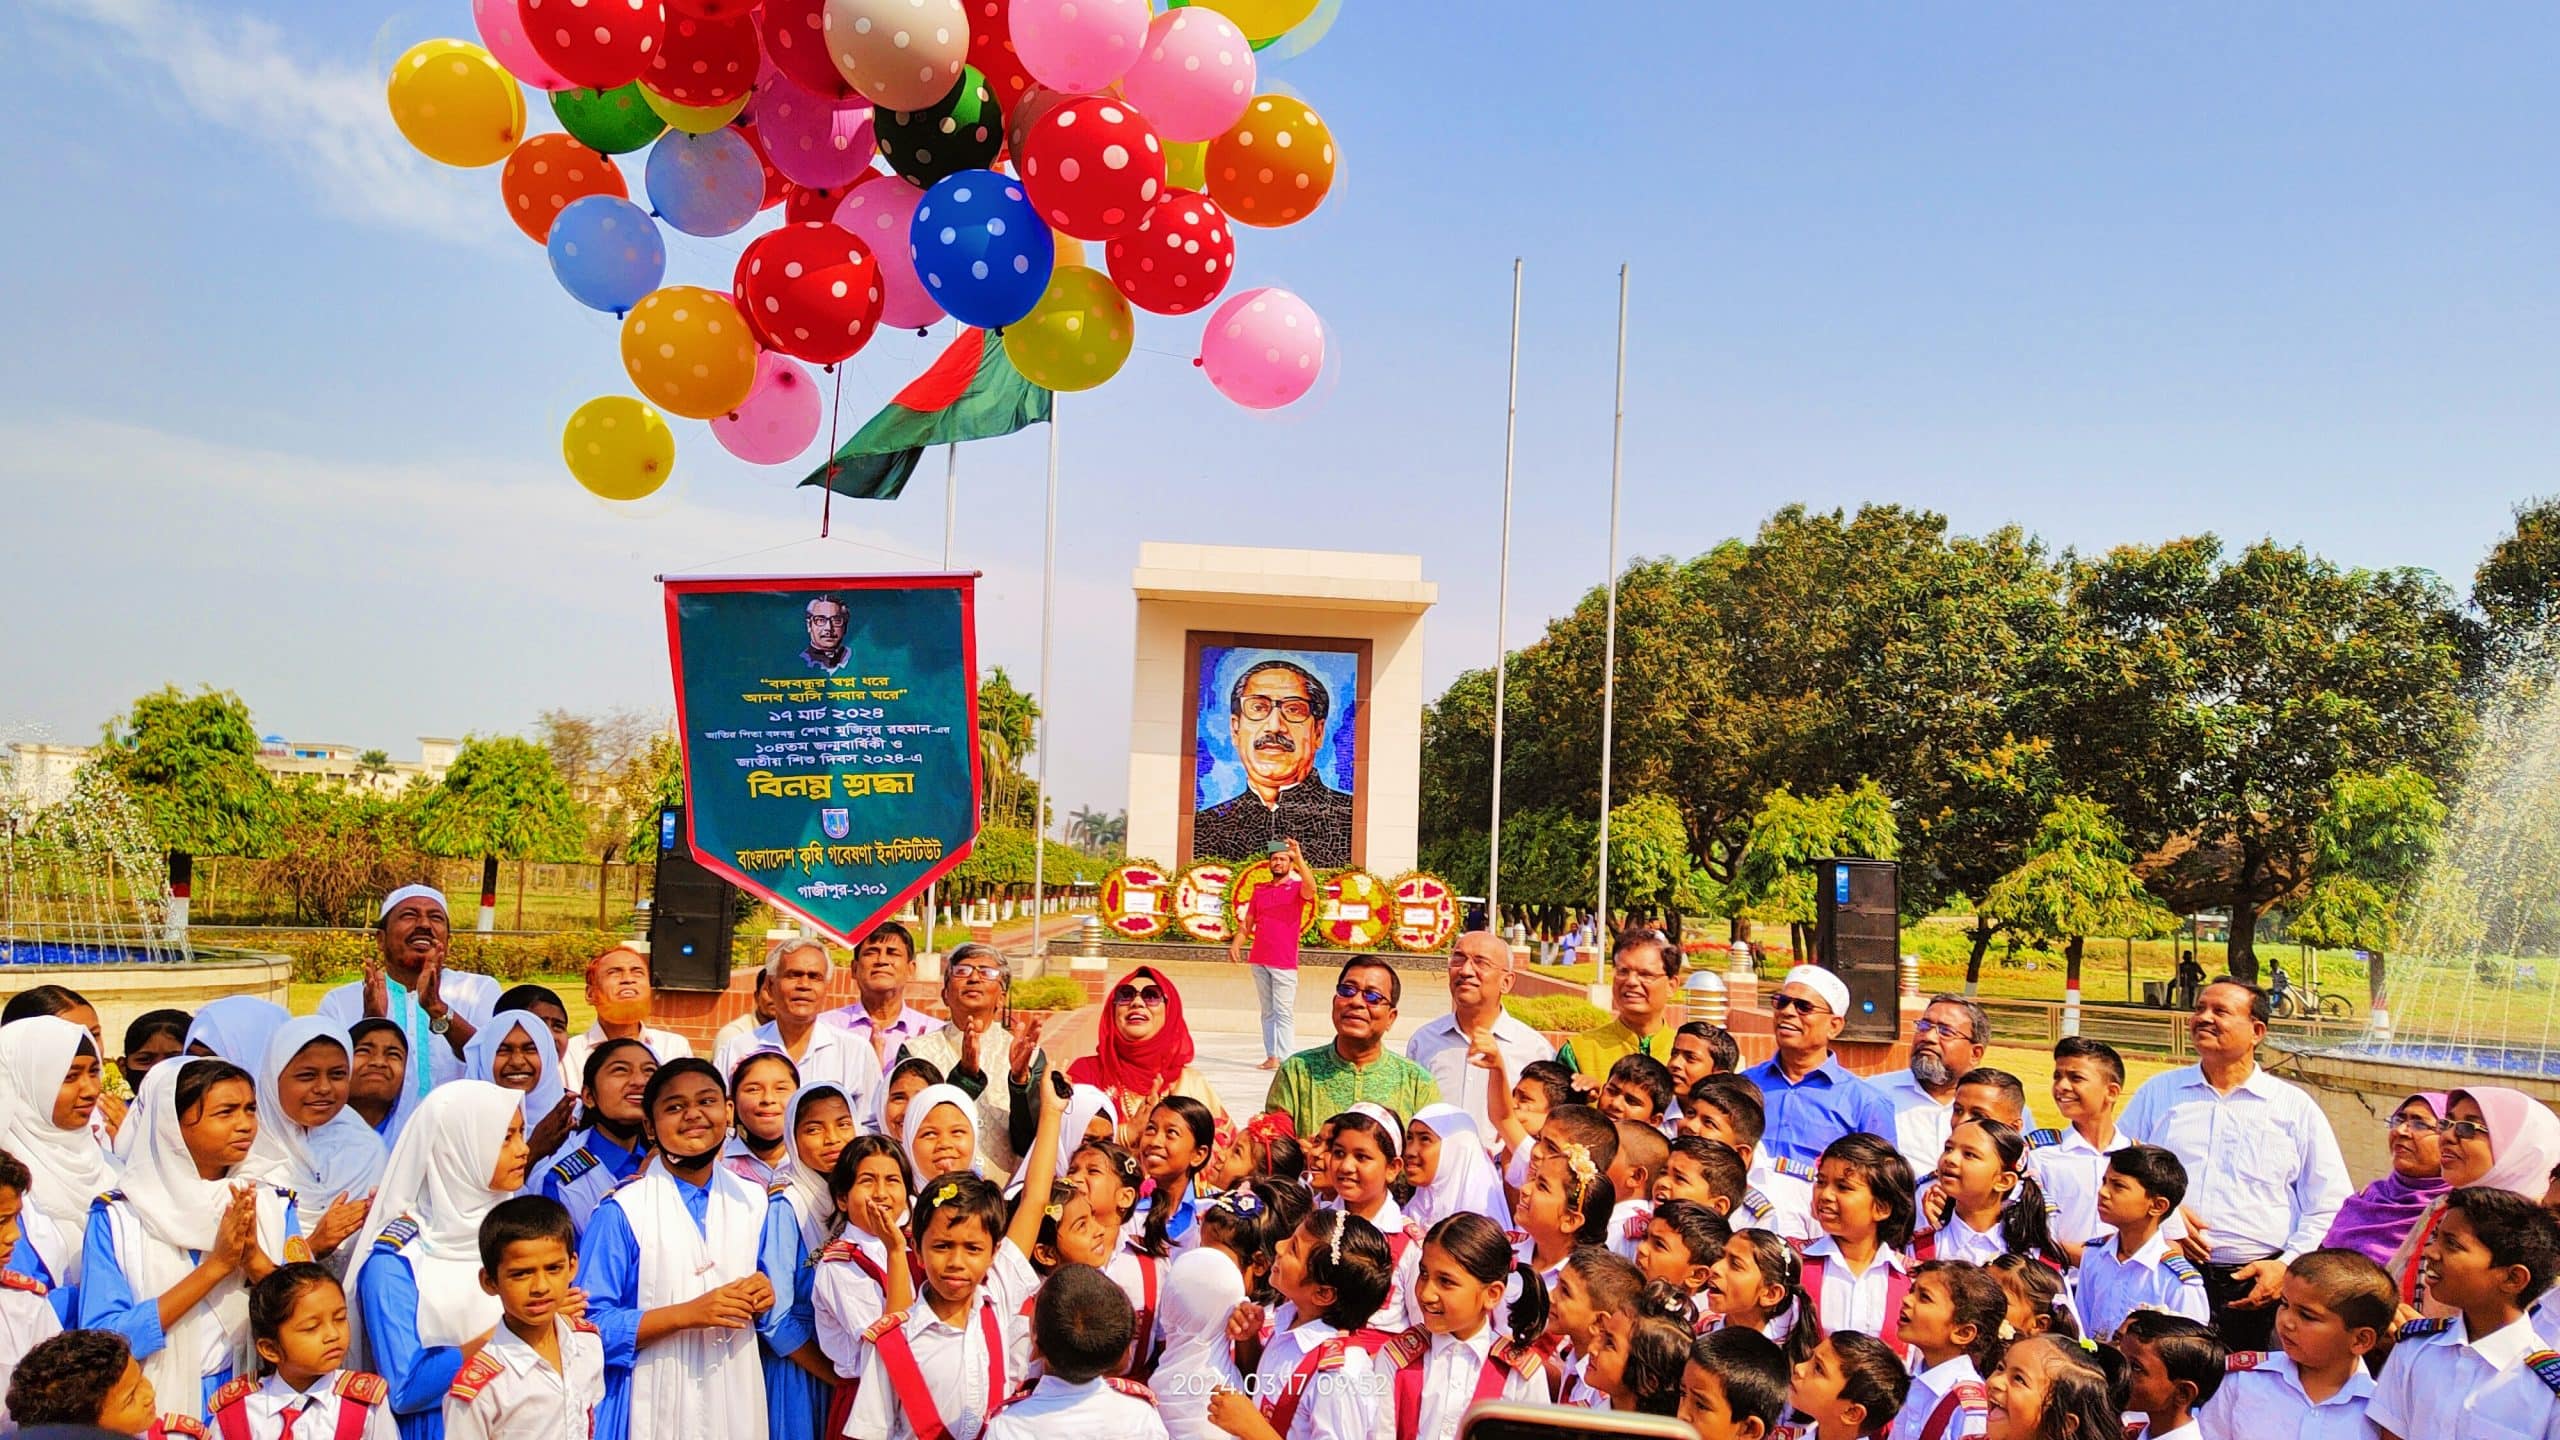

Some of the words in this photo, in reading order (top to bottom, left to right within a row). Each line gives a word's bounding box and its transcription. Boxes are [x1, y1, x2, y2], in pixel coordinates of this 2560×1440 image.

[862, 677, 890, 687] ধরে
[741, 693, 784, 703] আনব
[787, 690, 823, 703] হাসি
[826, 690, 865, 701] সবার
[768, 711, 793, 722] ১৭
[797, 706, 828, 721] মার্চ
[832, 707, 884, 720] ২০২৪
[800, 726, 831, 737] শেখ
[834, 722, 881, 738] মুজিবুর
[755, 741, 809, 753] ১০৪তম
[812, 736, 886, 752] জন্মবার্ষিকী
[890, 740, 903, 750] ও
[735, 756, 782, 768] জাতীয়
[787, 754, 816, 767] শিশু
[820, 753, 858, 765] দিবস
[863, 753, 923, 765] ২০২৪-এ
[747, 769, 834, 800] বিনম্র
[842, 772, 915, 797] শ্রদ্ধা
[736, 848, 796, 872] বাংলাদেশ
[797, 840, 824, 875] কৃষি
[827, 843, 873, 867] গবেষণা
[874, 837, 943, 864] ইনস্টিটিউট
[797, 880, 888, 900] গাজীপুর-১৭০১
